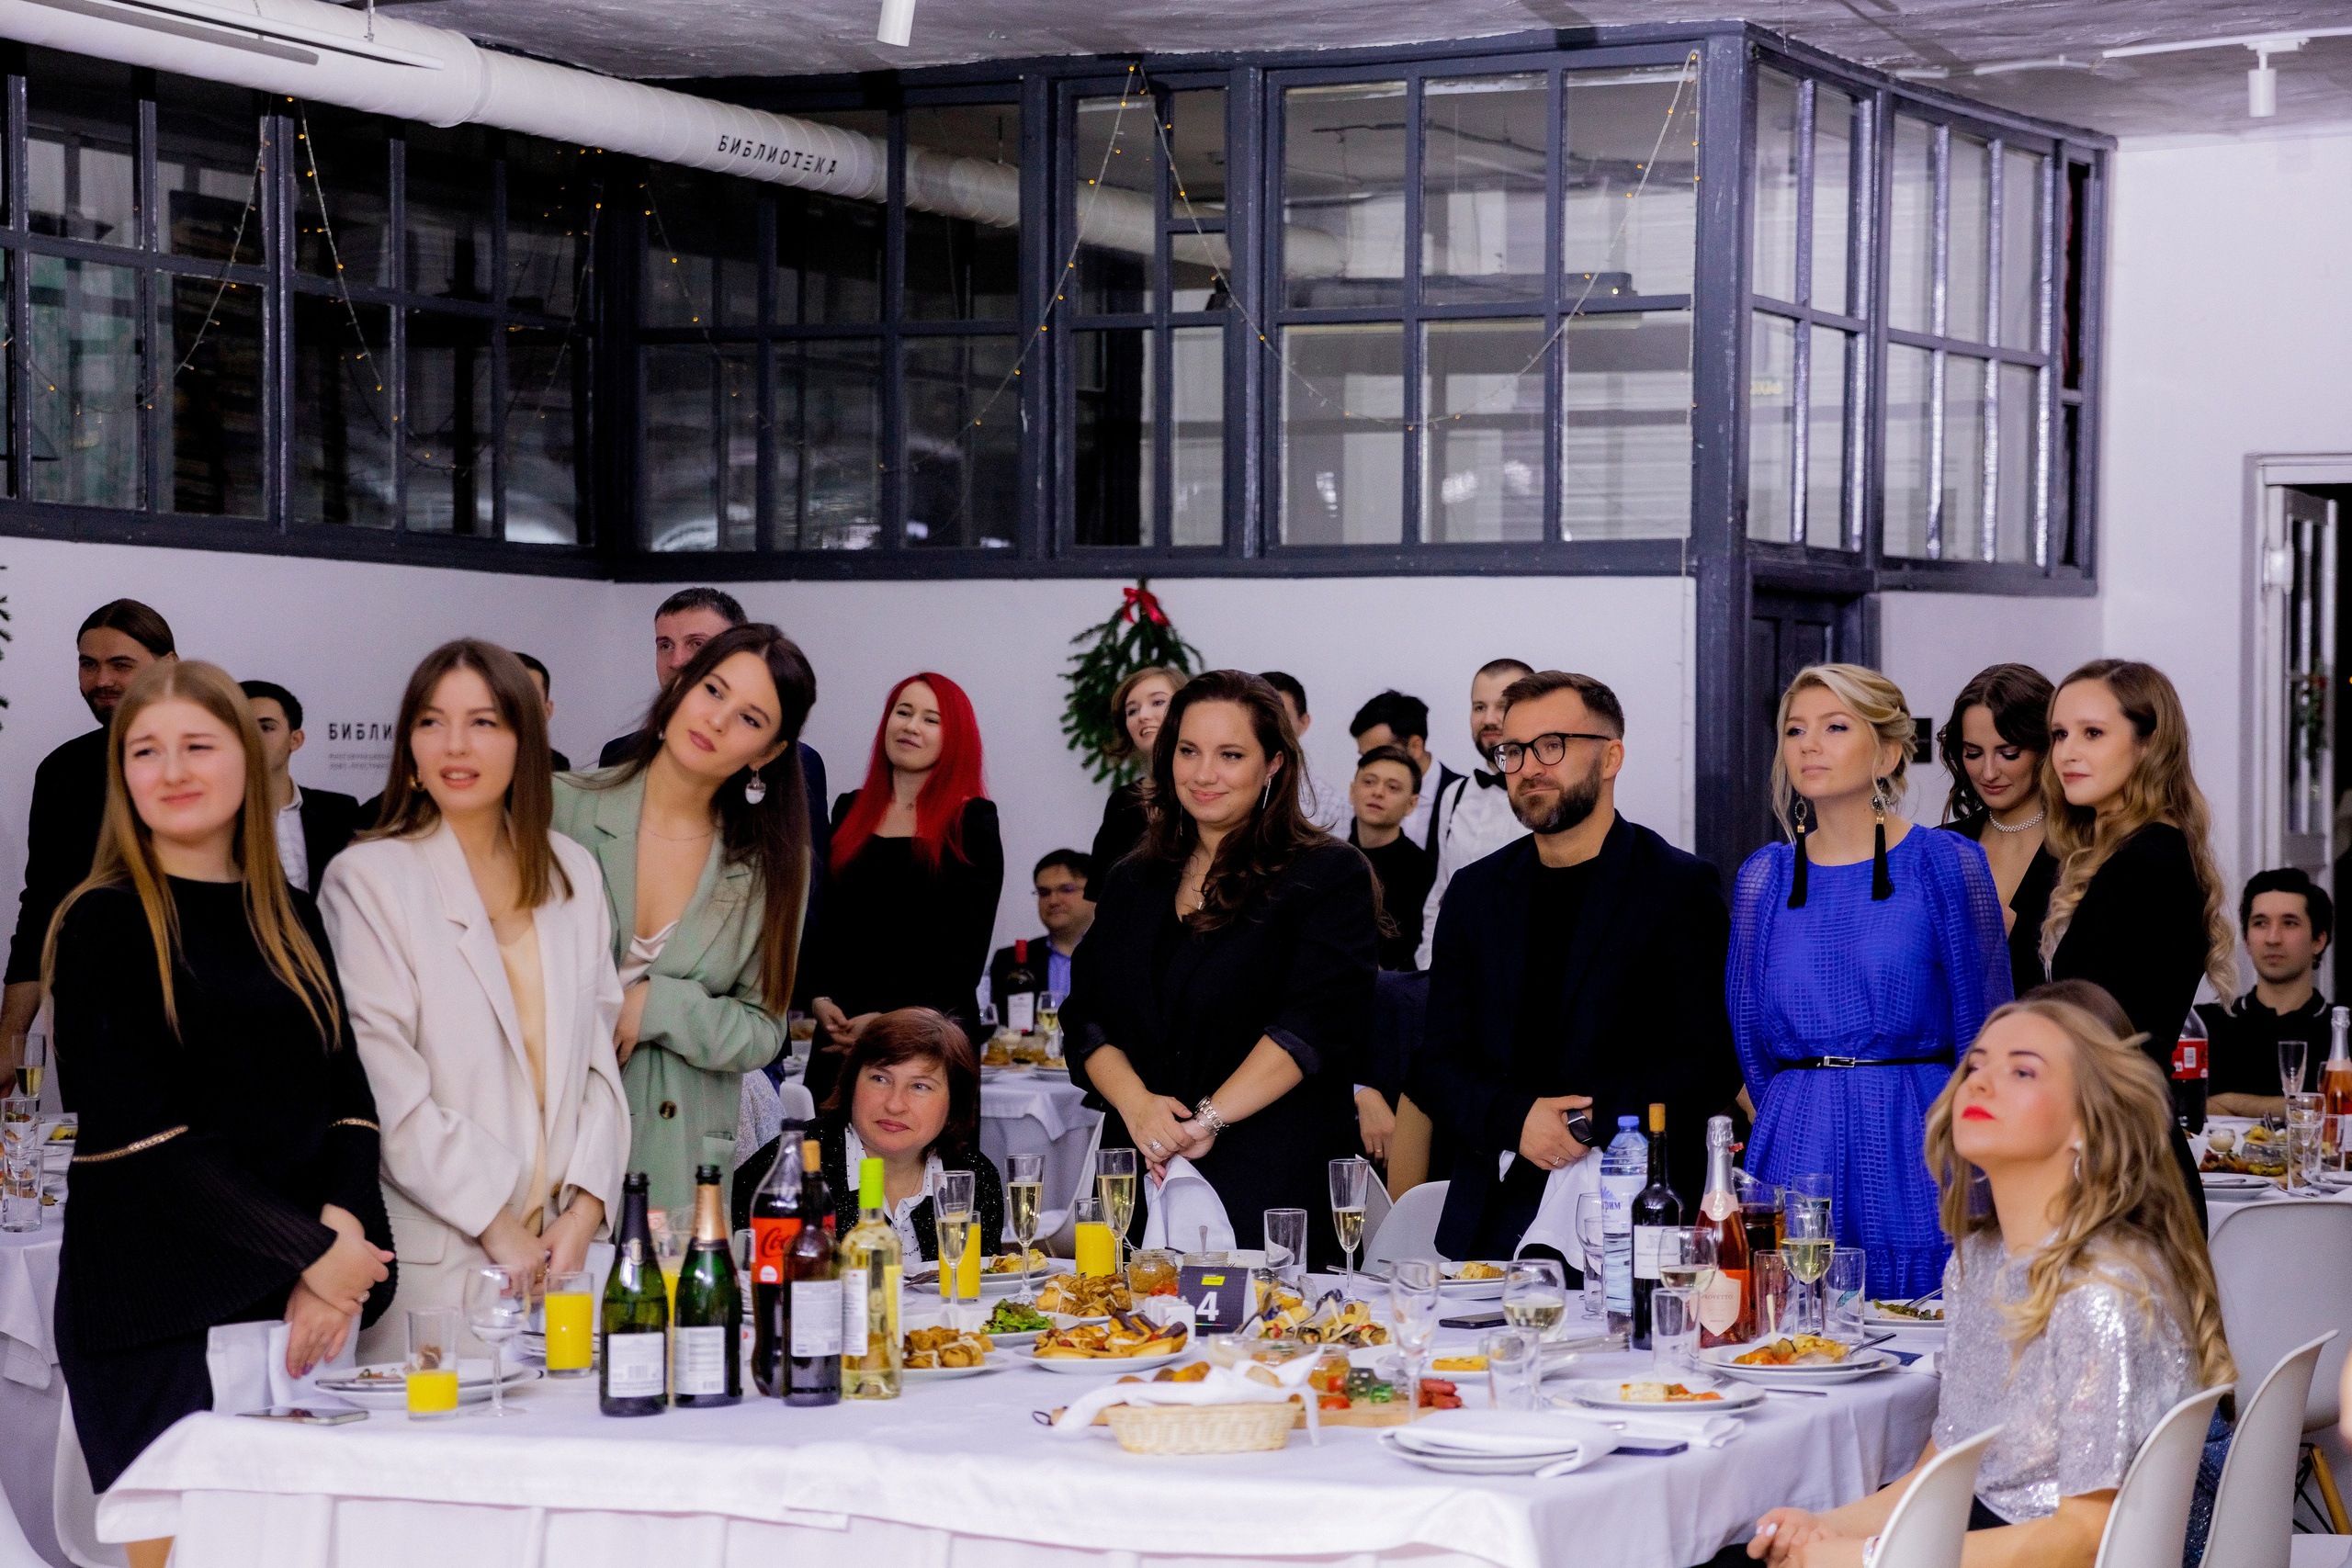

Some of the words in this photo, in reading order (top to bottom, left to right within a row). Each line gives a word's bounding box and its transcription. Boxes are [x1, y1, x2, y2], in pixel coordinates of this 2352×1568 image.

[718, 135, 838, 176] БИБЛИОТЕКА
[329, 723, 392, 740] БИБЛИ
[1195, 1291, 1219, 1321] 4
